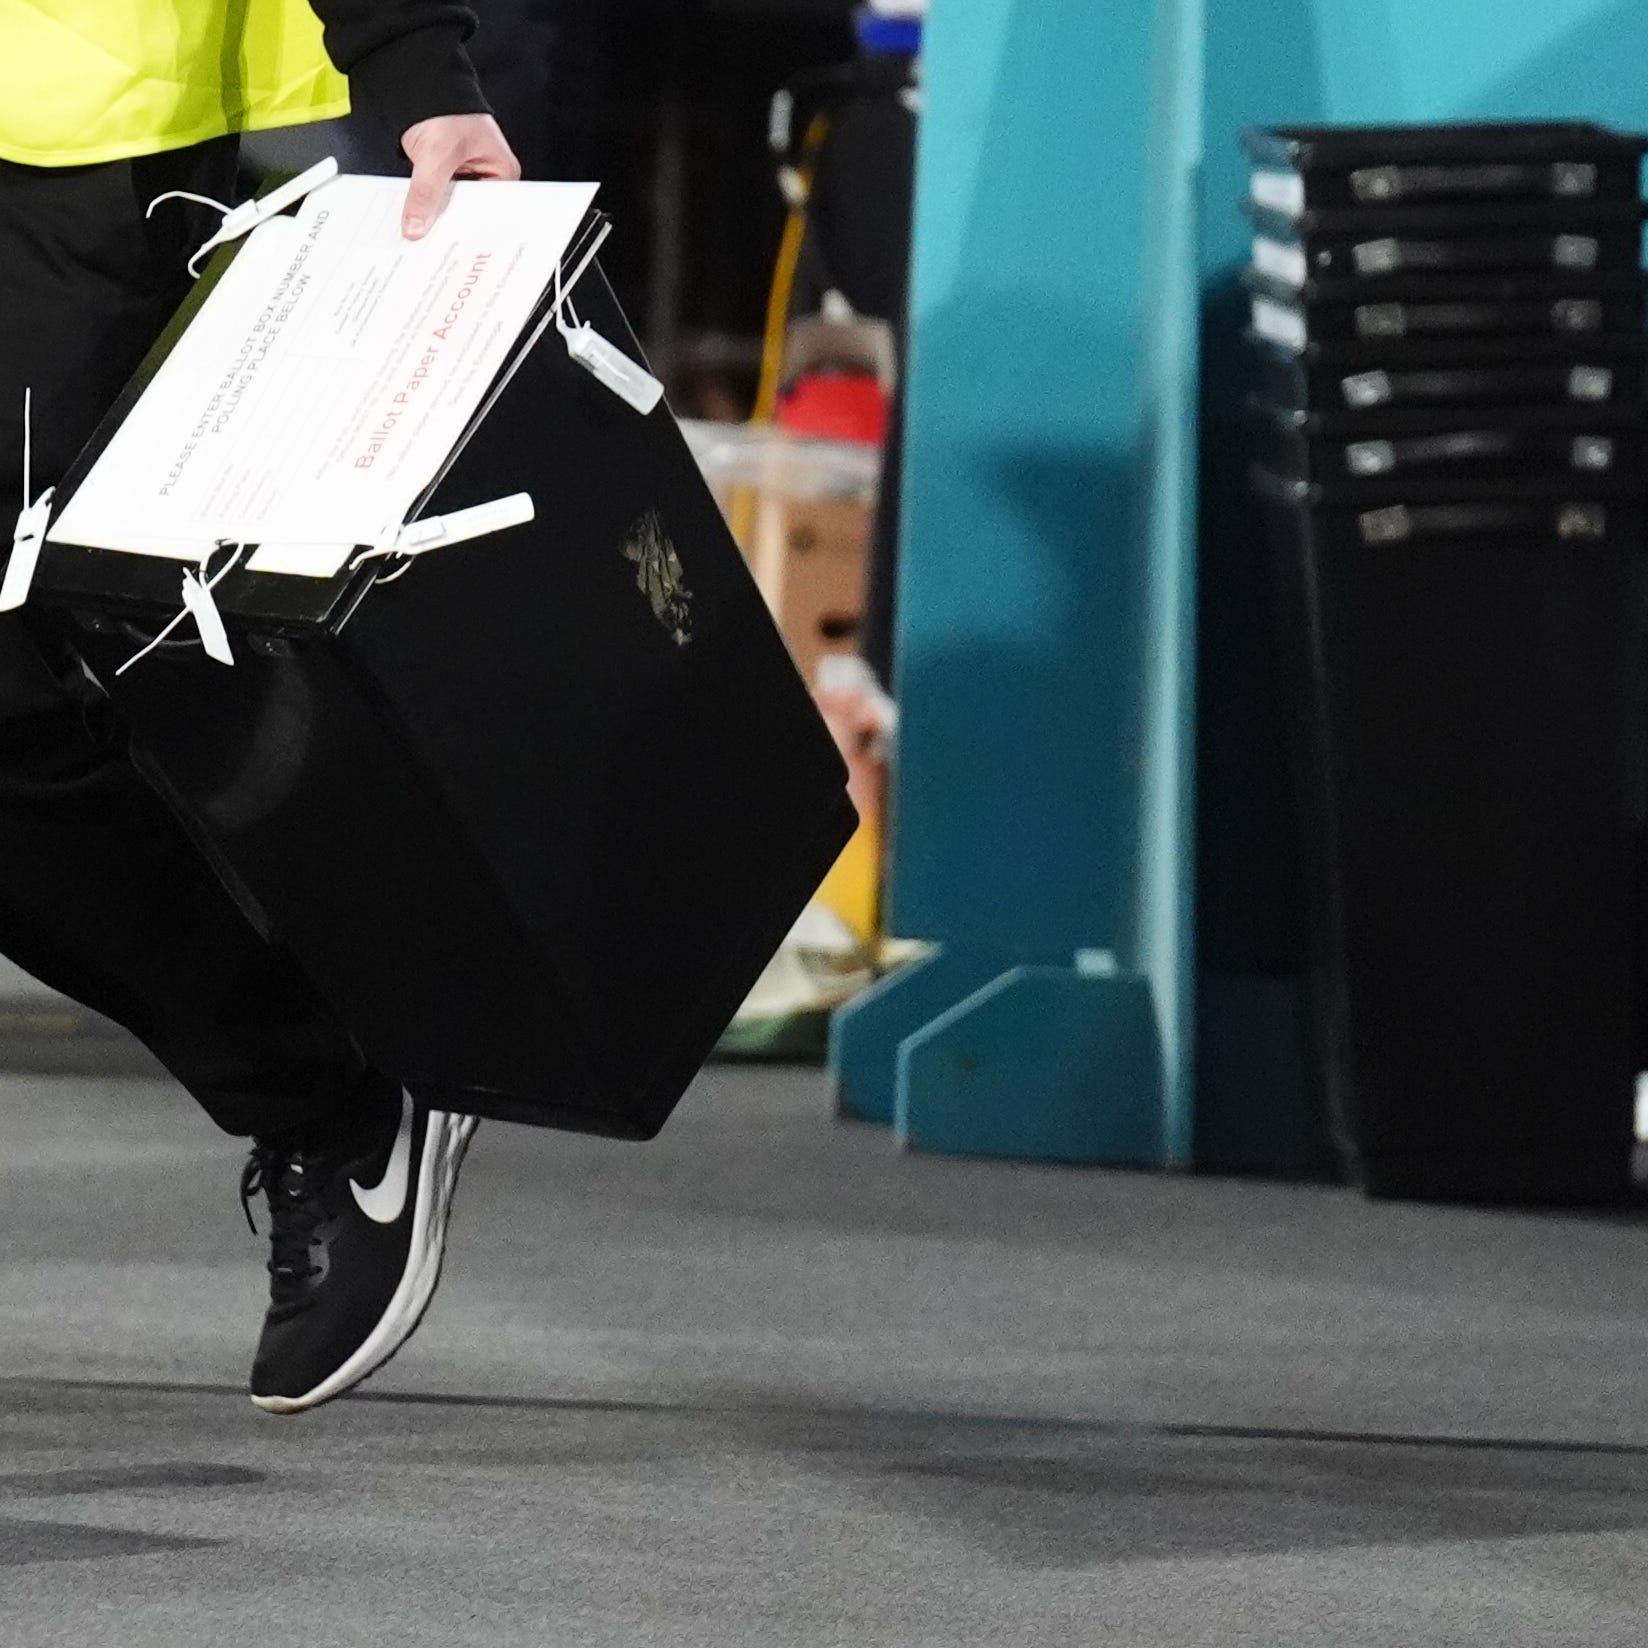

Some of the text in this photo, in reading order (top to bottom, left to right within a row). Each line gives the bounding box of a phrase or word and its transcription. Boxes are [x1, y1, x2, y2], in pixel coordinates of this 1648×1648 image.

[155, 209, 332, 495] PLEASE ENTER BALLOT BOX NUMBER AND
[209, 274, 313, 432] POLLING PLACE BELOW
[351, 253, 492, 468] Ballot Paper Account
